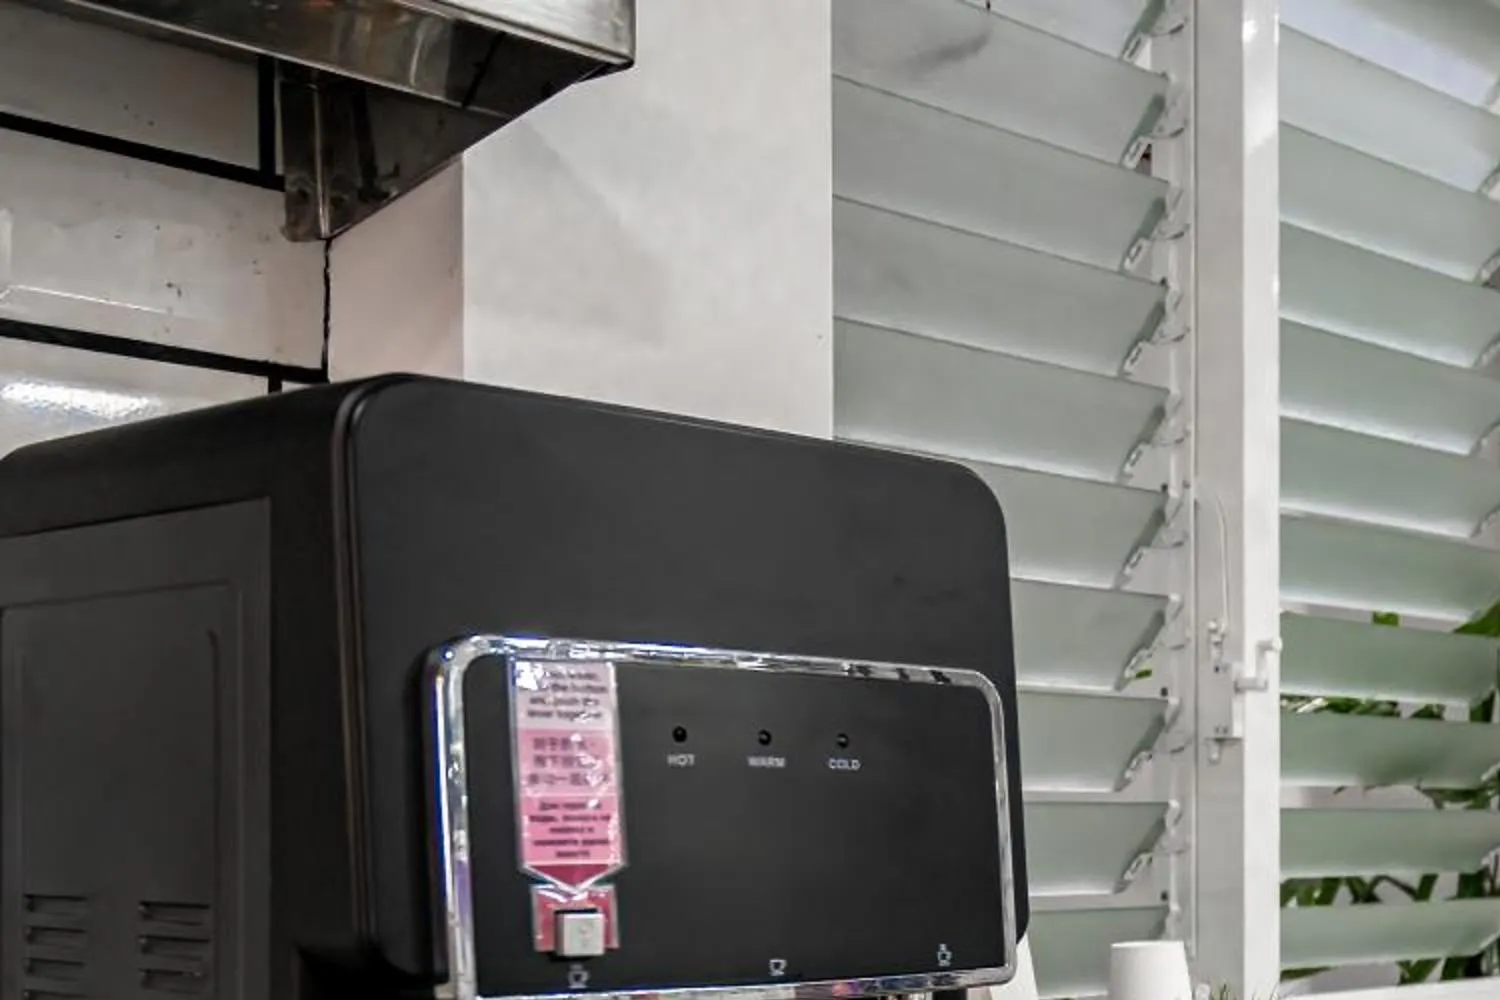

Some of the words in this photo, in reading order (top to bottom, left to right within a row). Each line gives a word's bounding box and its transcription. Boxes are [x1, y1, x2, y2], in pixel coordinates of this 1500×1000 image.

[667, 754, 695, 767] HOT
[747, 756, 786, 768] WARM
[828, 758, 861, 770] COLD
